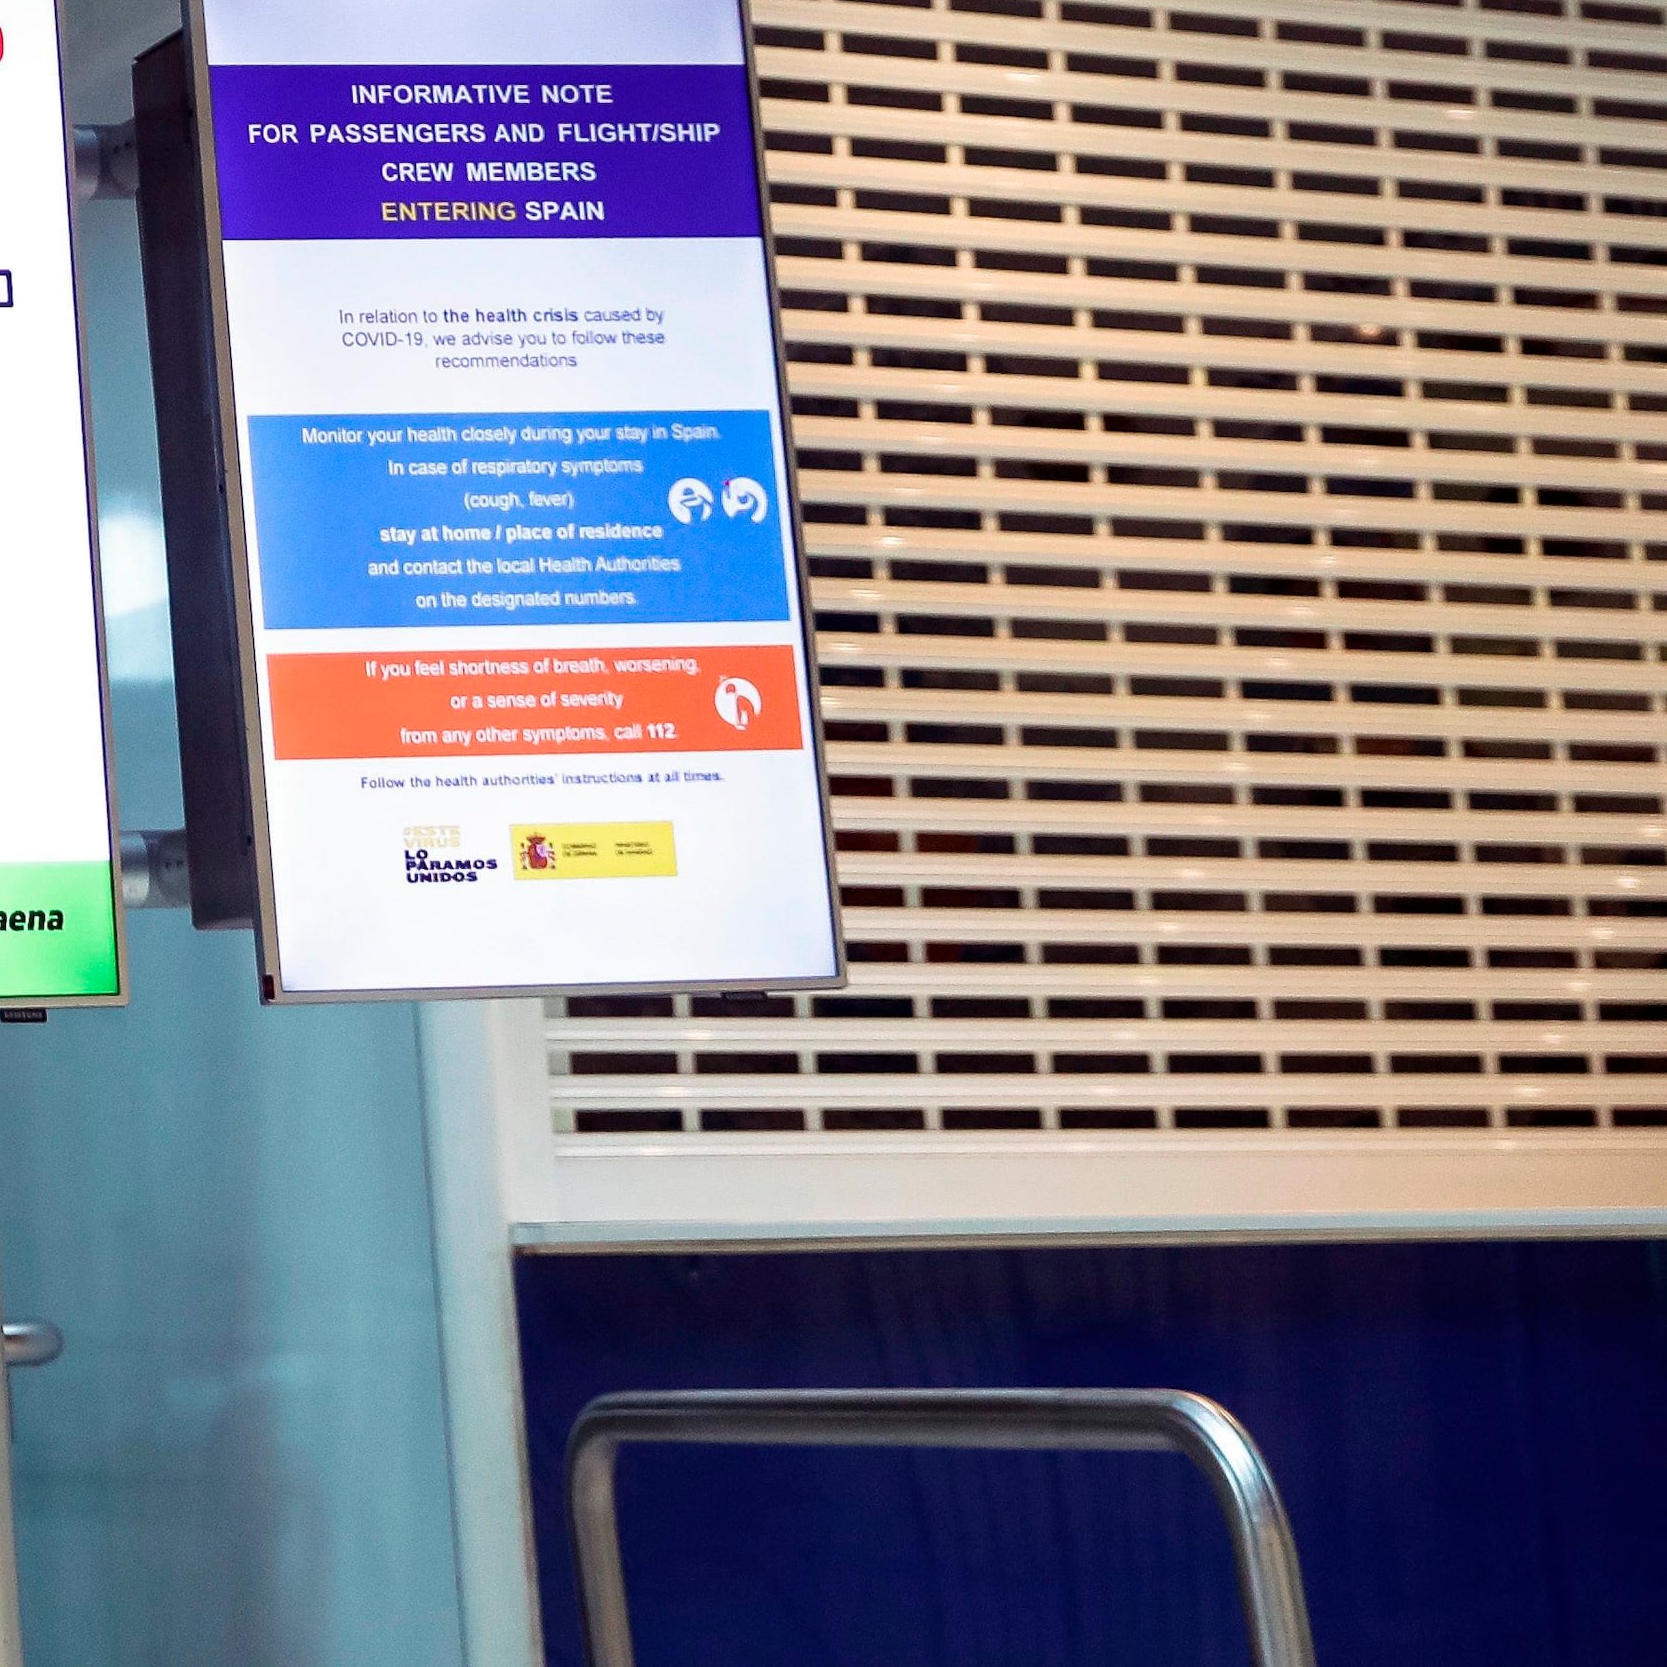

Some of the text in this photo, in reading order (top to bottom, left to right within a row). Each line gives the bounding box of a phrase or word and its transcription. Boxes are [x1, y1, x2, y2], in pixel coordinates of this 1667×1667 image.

[352, 85, 613, 104] INFORMATIVE NOTE
[249, 123, 720, 143] FOR PASSENGERS AND FLIGHT/SHIP
[382, 162, 596, 181] CREW MEMBERS
[382, 201, 604, 221] ENTERING SPAIN
[339, 308, 663, 324] In relation to the health crisis caused by
[433, 335, 456, 345] we
[462, 332, 512, 345] advise
[518, 334, 547, 348] you
[552, 332, 566, 345] to
[572, 330, 617, 345] follow
[622, 331, 665, 344] these
[436, 354, 577, 368] recommendations
[380, 524, 663, 545] stay at home place of residence
[405, 850, 428, 860] LO
[407, 872, 477, 883] UNIDOS
